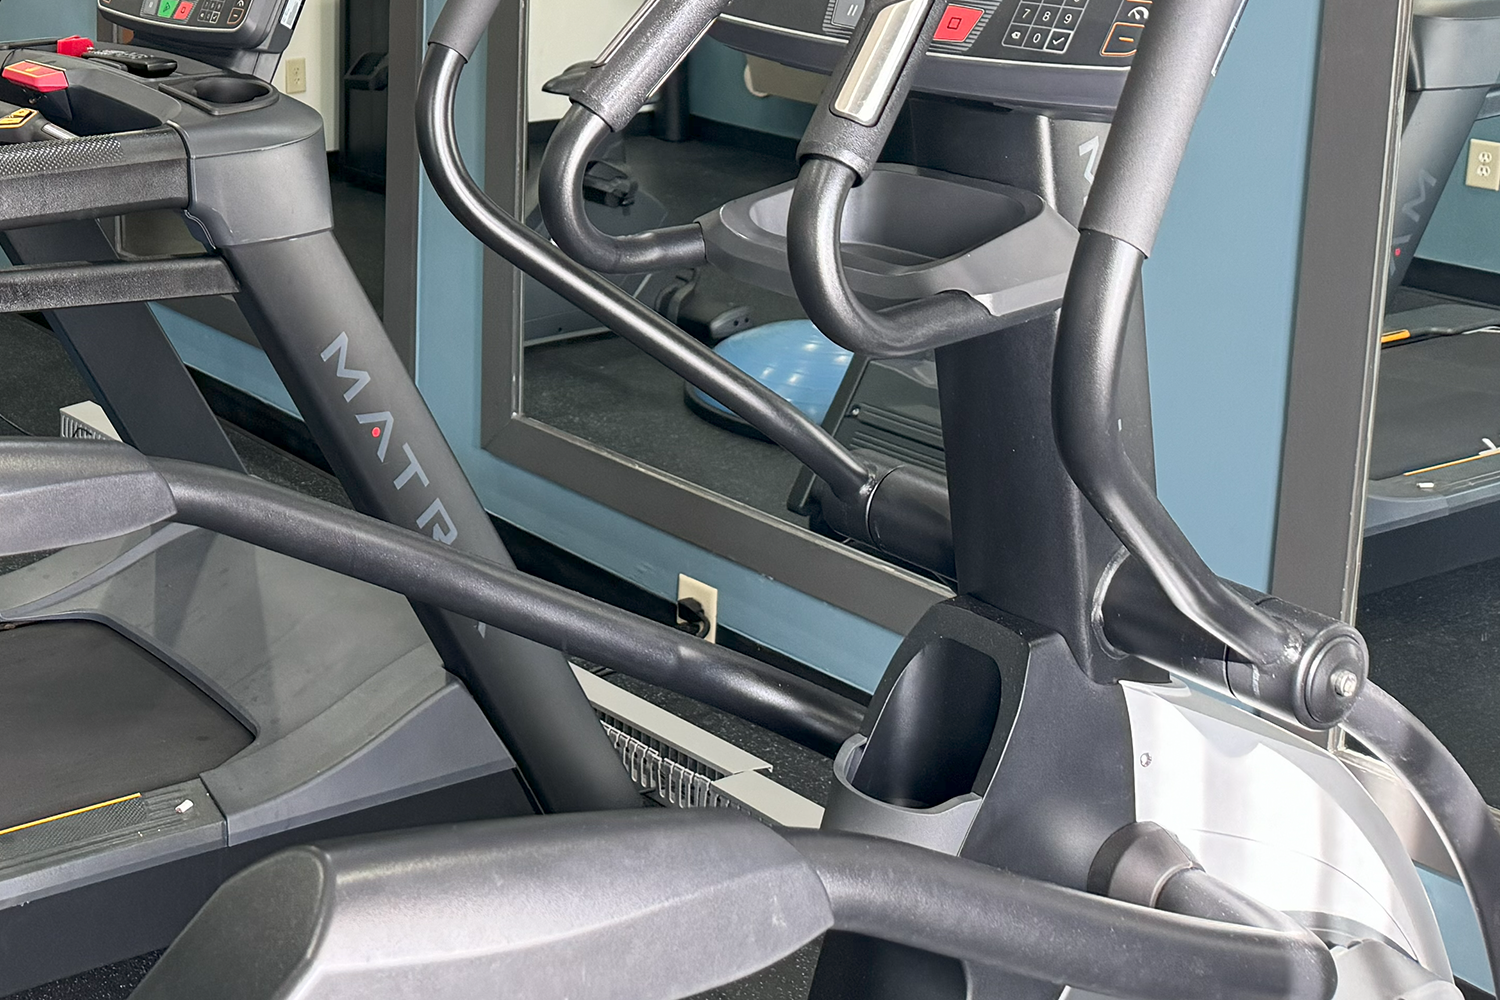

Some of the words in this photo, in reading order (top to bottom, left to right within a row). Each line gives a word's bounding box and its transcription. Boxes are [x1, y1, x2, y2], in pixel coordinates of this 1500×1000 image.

[1022, 8, 1031, 19] 7
[1042, 11, 1051, 22] 8
[1063, 13, 1073, 25] 9
[1032, 32, 1041, 44] 0
